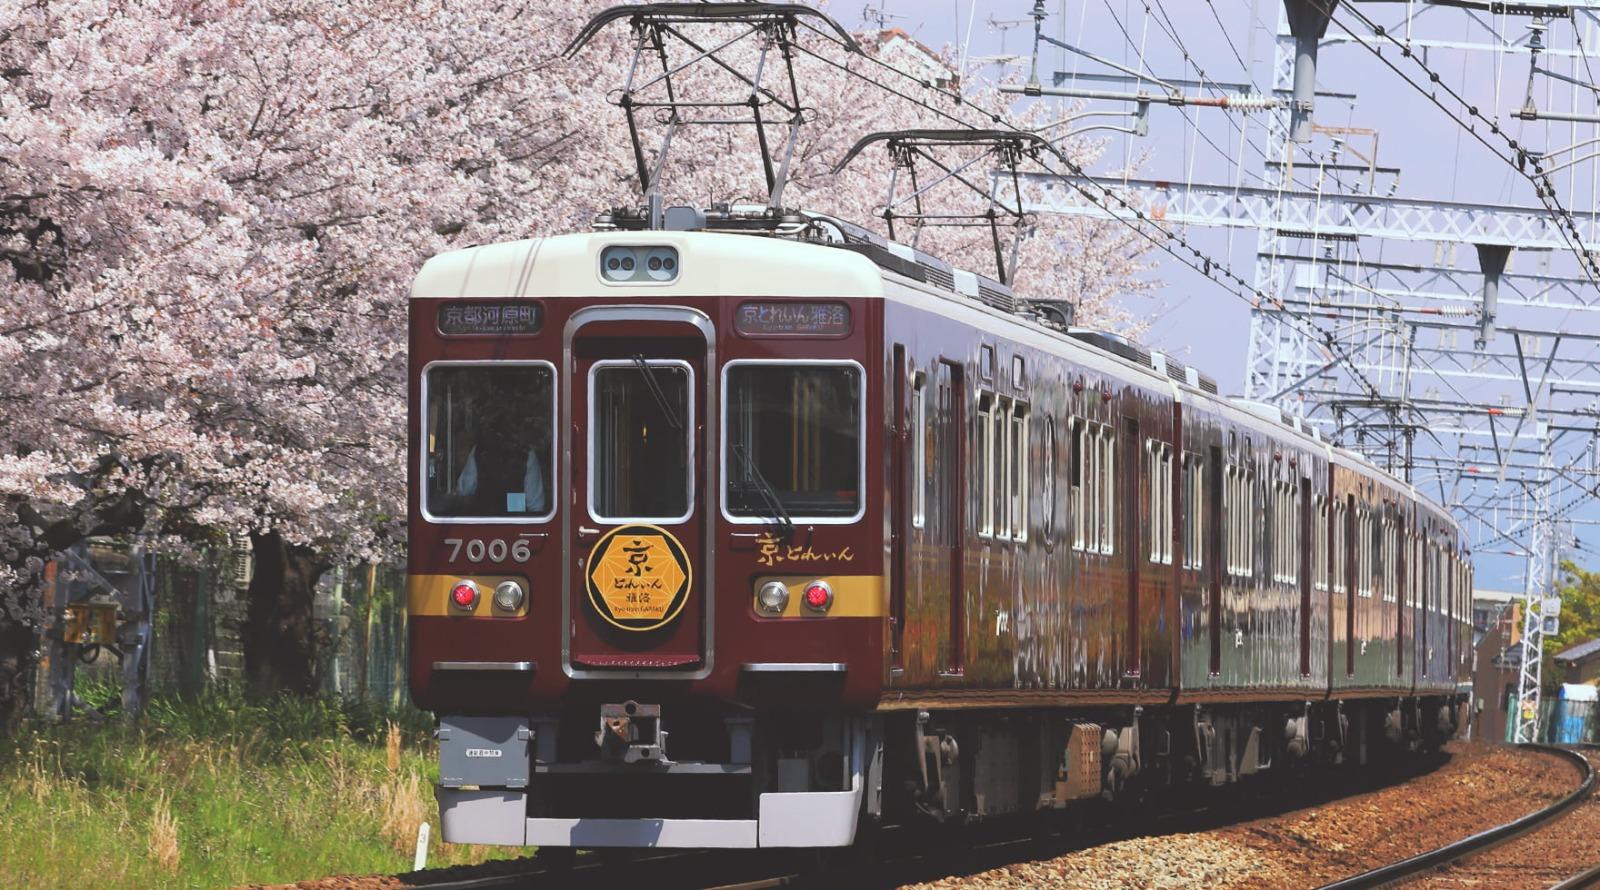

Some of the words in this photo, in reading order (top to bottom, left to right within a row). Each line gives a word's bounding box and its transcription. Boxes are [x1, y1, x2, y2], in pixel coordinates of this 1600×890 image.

[446, 305, 536, 325] 京都河原町
[444, 538, 531, 563] 7006
[623, 540, 654, 577] 京
[755, 532, 854, 566] 京とれいん
[614, 578, 662, 589] とれいん
